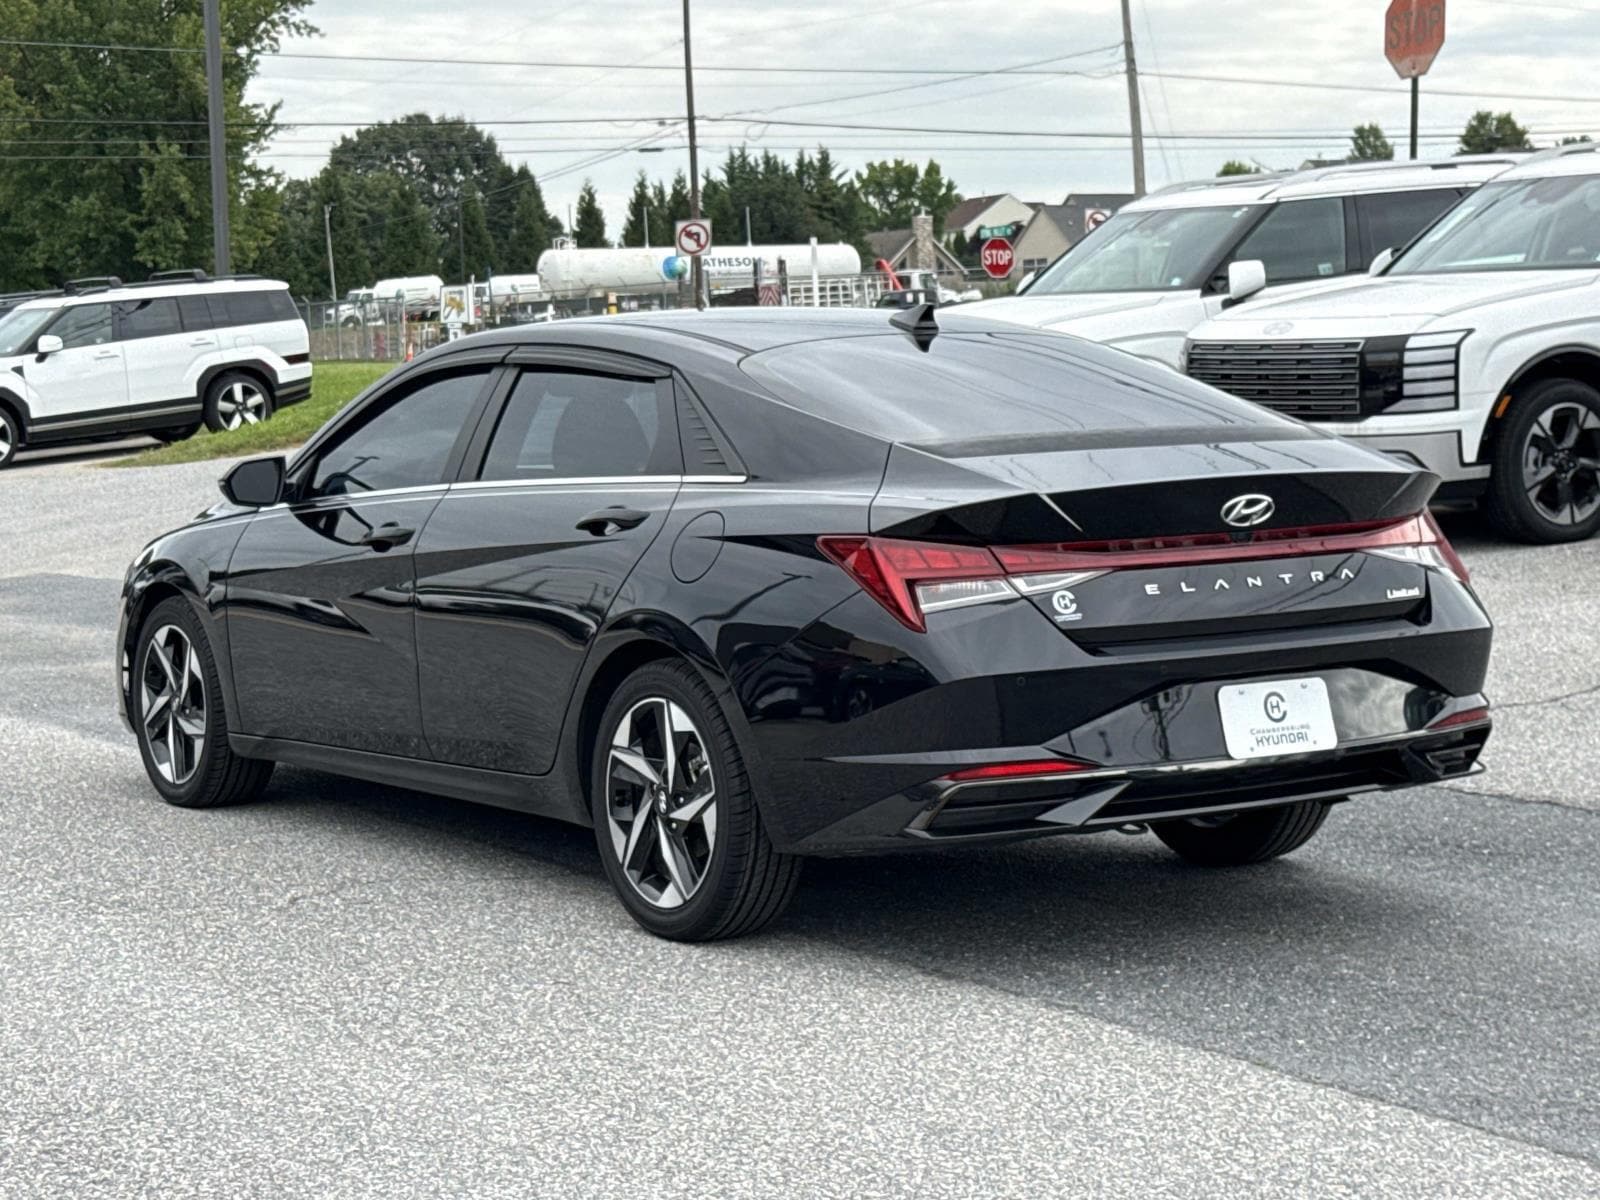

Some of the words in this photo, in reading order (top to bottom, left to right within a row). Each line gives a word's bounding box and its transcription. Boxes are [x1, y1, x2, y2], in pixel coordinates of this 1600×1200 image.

[1390, 4, 1441, 49] STOP
[700, 256, 762, 268] ATHESO
[984, 249, 1012, 266] STOP
[1144, 568, 1354, 595] ELANTRA
[1255, 731, 1309, 748] HYUNDAI
